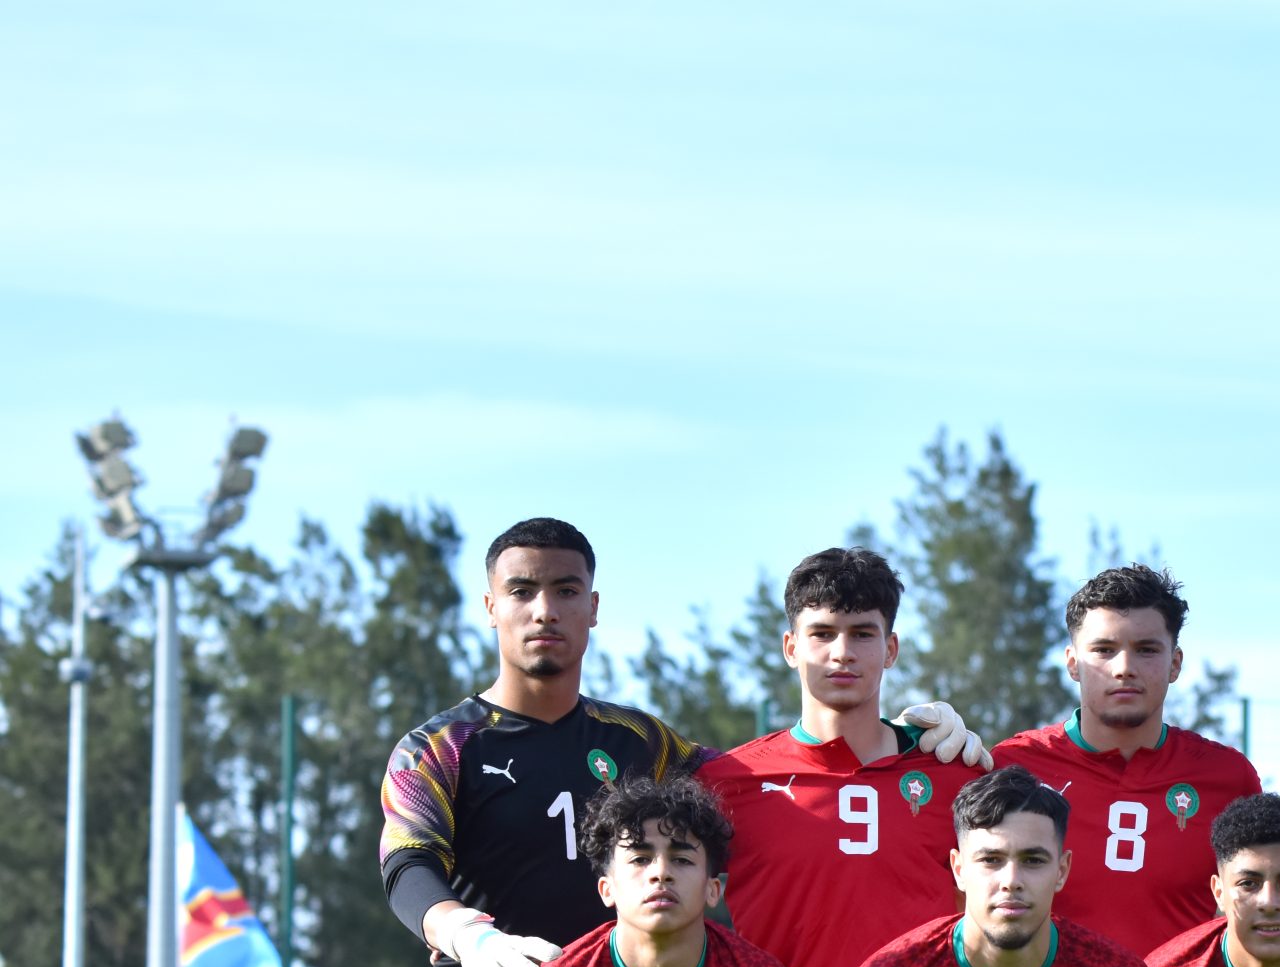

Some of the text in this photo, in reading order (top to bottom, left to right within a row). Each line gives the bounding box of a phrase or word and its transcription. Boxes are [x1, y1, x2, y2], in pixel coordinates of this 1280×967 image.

[547, 791, 578, 860] 1
[838, 785, 879, 855] 9
[1105, 801, 1149, 873] 8
